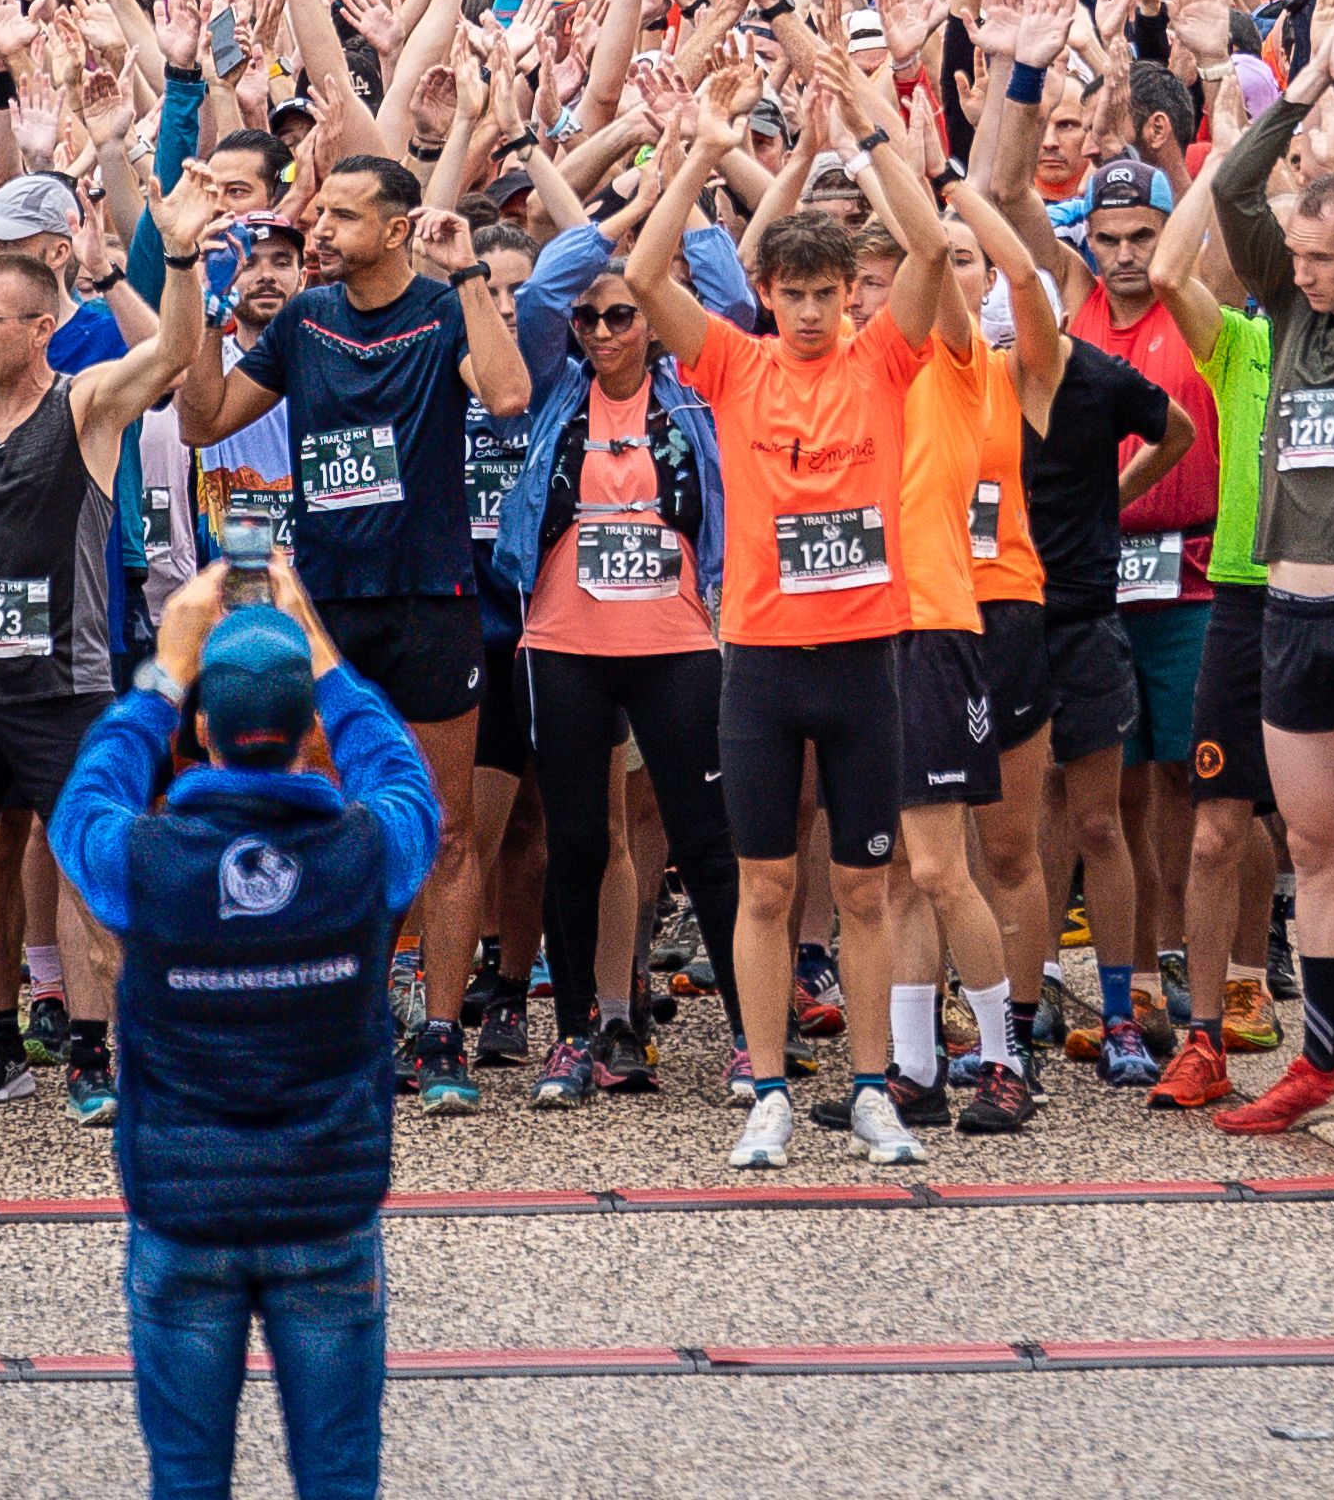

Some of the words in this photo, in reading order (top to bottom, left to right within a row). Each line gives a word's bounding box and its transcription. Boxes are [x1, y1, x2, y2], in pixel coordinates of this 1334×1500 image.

[319, 435, 341, 446] TRAIL
[343, 432, 352, 442] 12
[353, 429, 367, 440] KM
[319, 455, 376, 489] 1086
[482, 464, 506, 474] TRAIL
[510, 464, 517, 473] 12
[253, 495, 275, 504] TRAIL
[803, 515, 828, 527] TRAIL
[832, 514, 841, 523] 12
[843, 512, 857, 523] KM
[605, 526, 629, 535] TRAIL
[633, 526, 642, 536] 12
[644, 527, 657, 537] KM
[1141, 539, 1155, 548] KM
[800, 538, 864, 570] 1206
[599, 552, 661, 578] 1325
[1117, 556, 1158, 581] 87
[8, 583, 22, 593] KM
